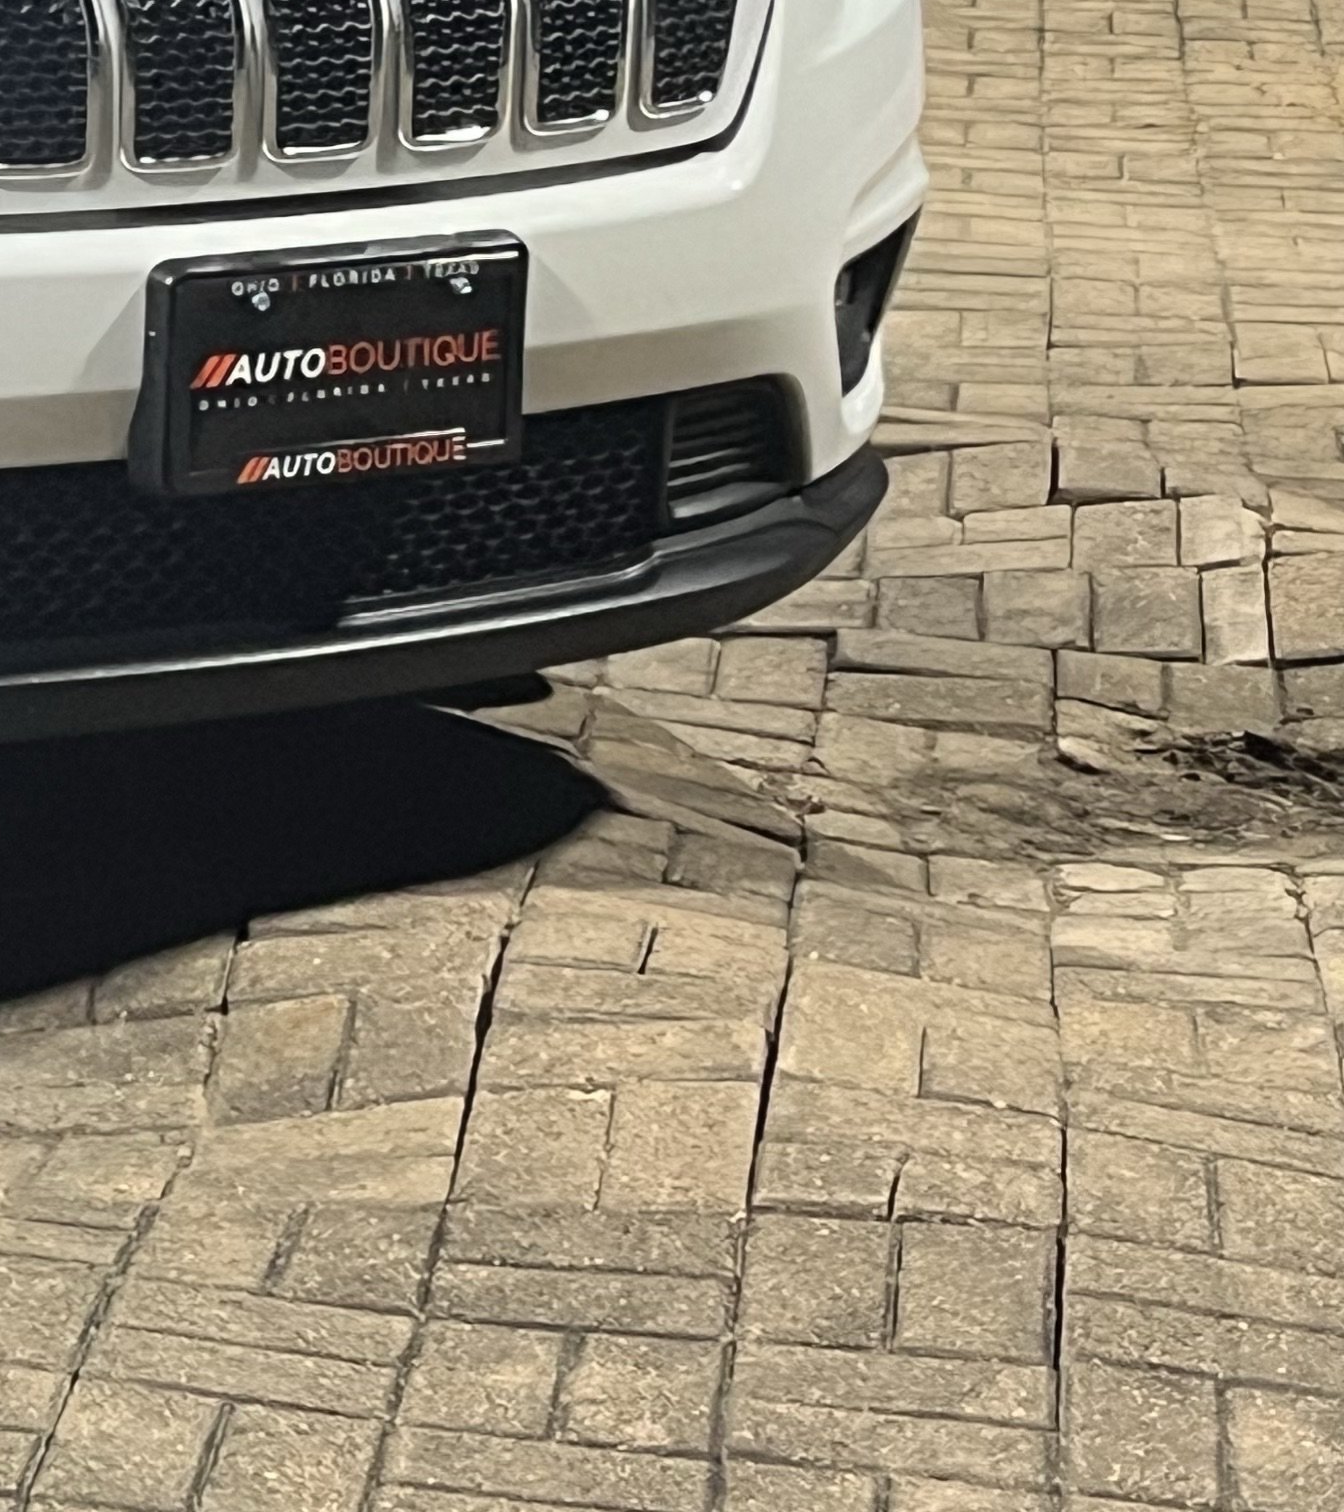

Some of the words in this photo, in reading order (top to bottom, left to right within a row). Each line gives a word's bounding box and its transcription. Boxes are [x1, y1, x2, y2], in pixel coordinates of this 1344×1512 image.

[309, 268, 395, 288] FLORIDA
[226, 330, 501, 385] AUTOBOUTIQUE
[263, 436, 467, 480] AUTOBOUTIQUE
